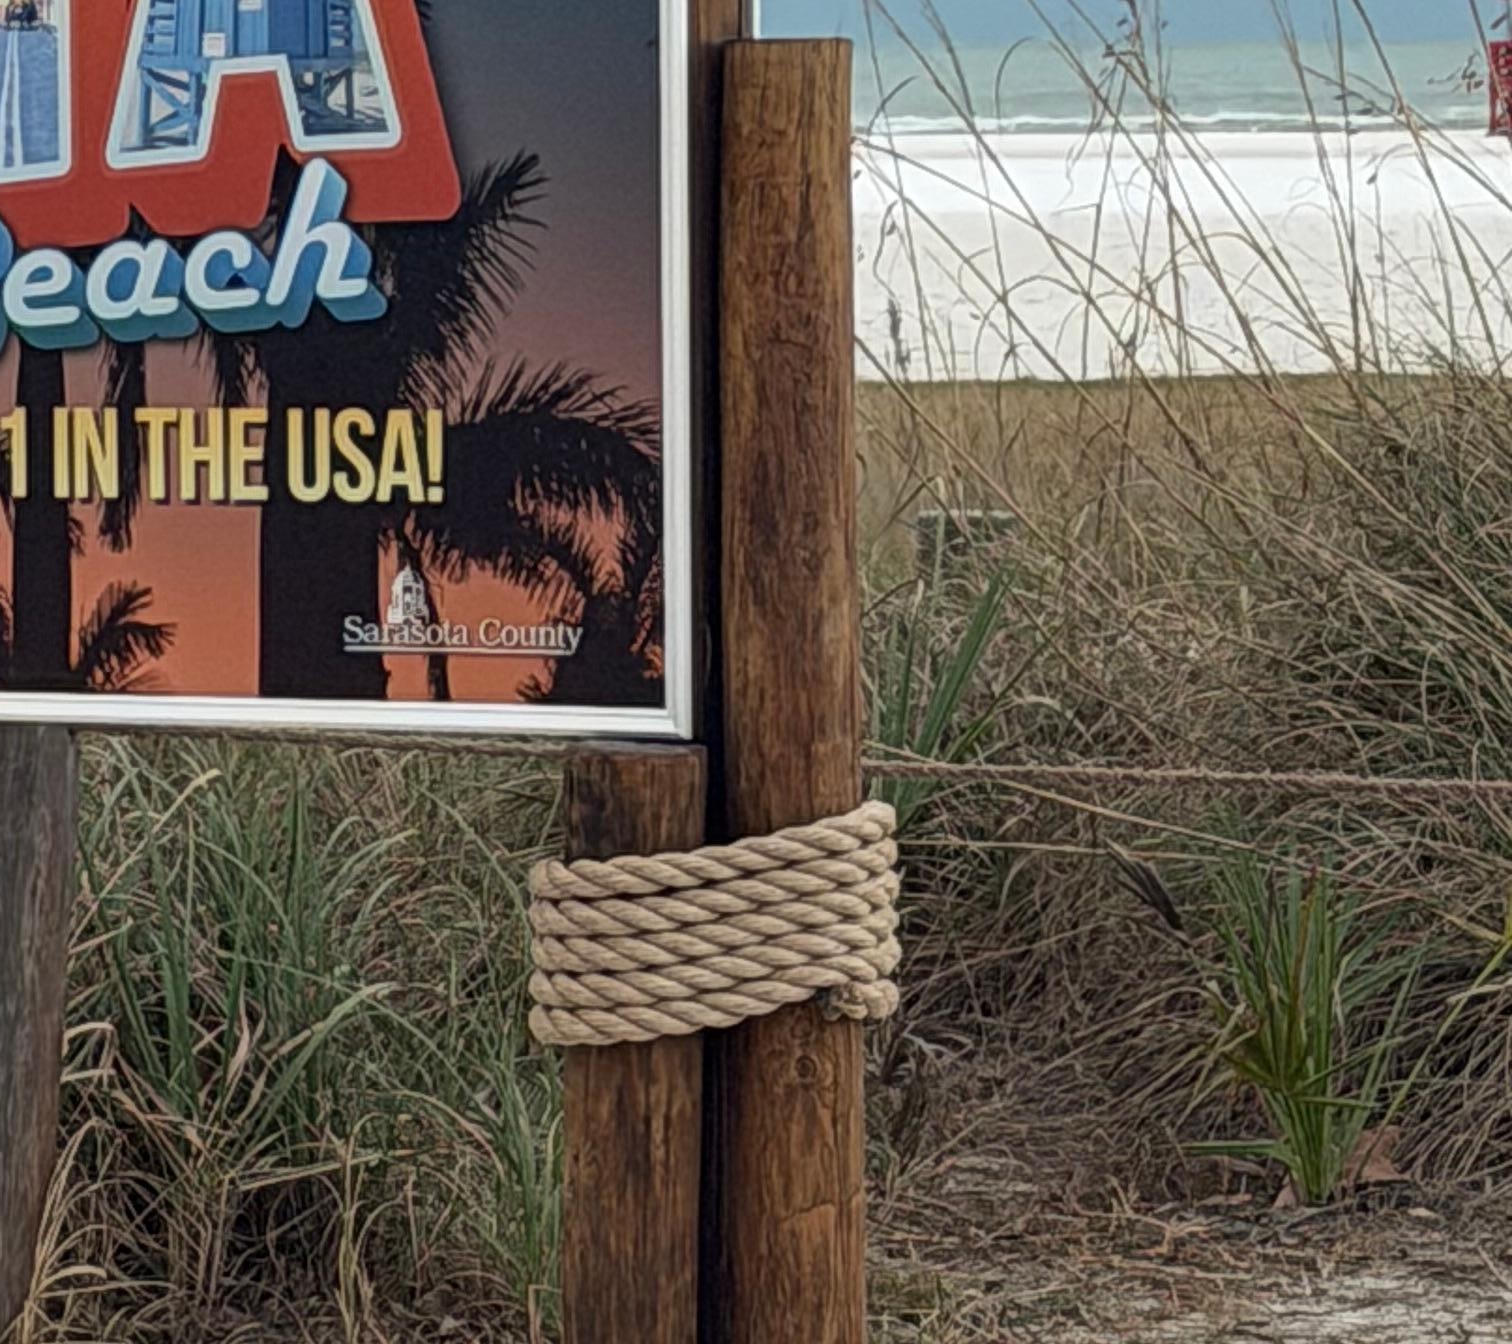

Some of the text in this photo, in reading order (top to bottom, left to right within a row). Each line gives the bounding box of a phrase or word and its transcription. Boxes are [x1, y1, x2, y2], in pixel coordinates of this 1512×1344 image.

[53, 406, 119, 501] IN
[134, 406, 270, 502] THE
[286, 407, 445, 504] USA!
[342, 615, 584, 653] Sarasota County
